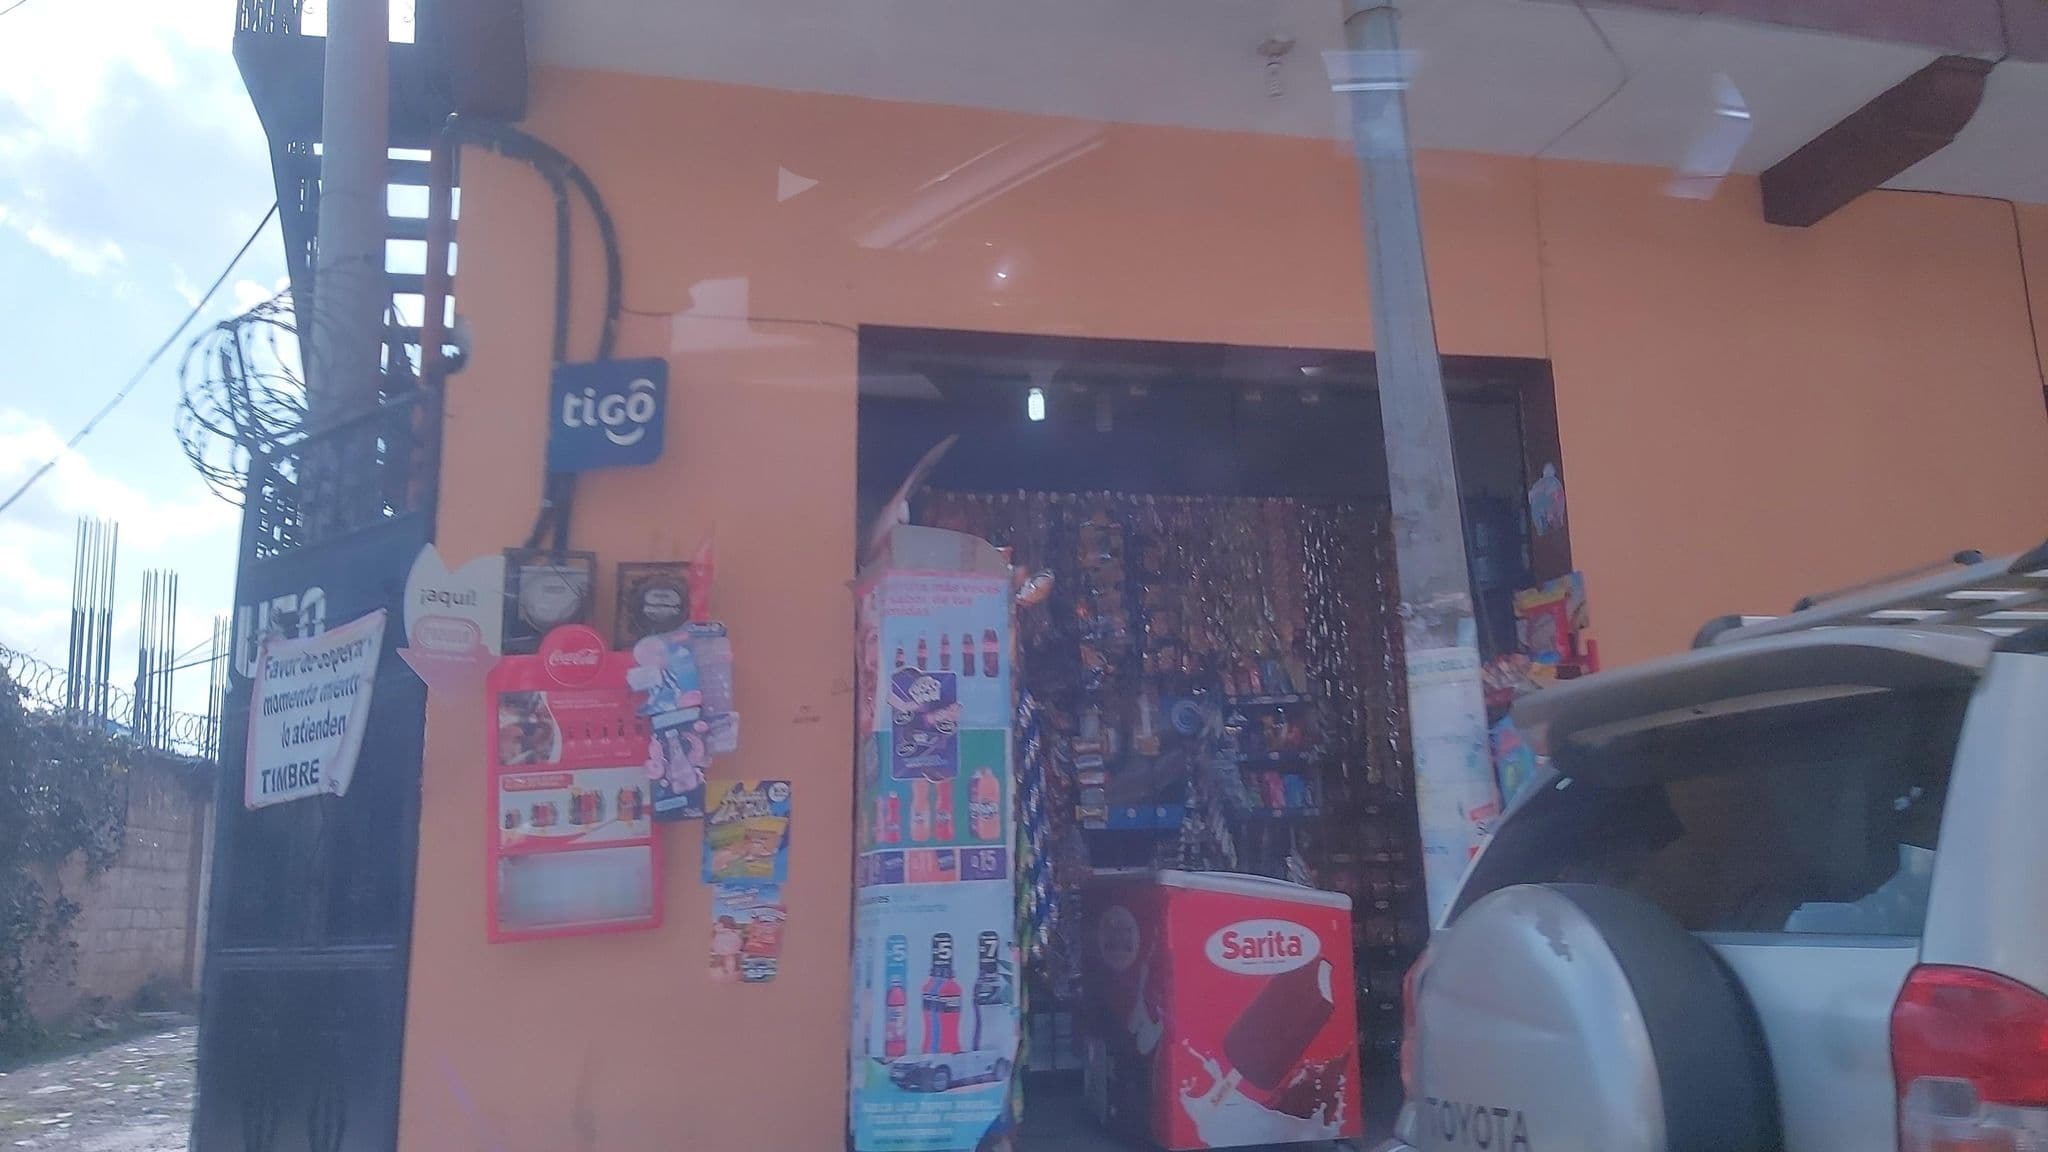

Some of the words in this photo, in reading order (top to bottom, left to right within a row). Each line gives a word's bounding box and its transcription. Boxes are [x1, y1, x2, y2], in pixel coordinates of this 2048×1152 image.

[262, 758, 320, 794] TIMBRE
[1222, 930, 1303, 959] Sarita
[1424, 1097, 1533, 1152] TOYOTA
